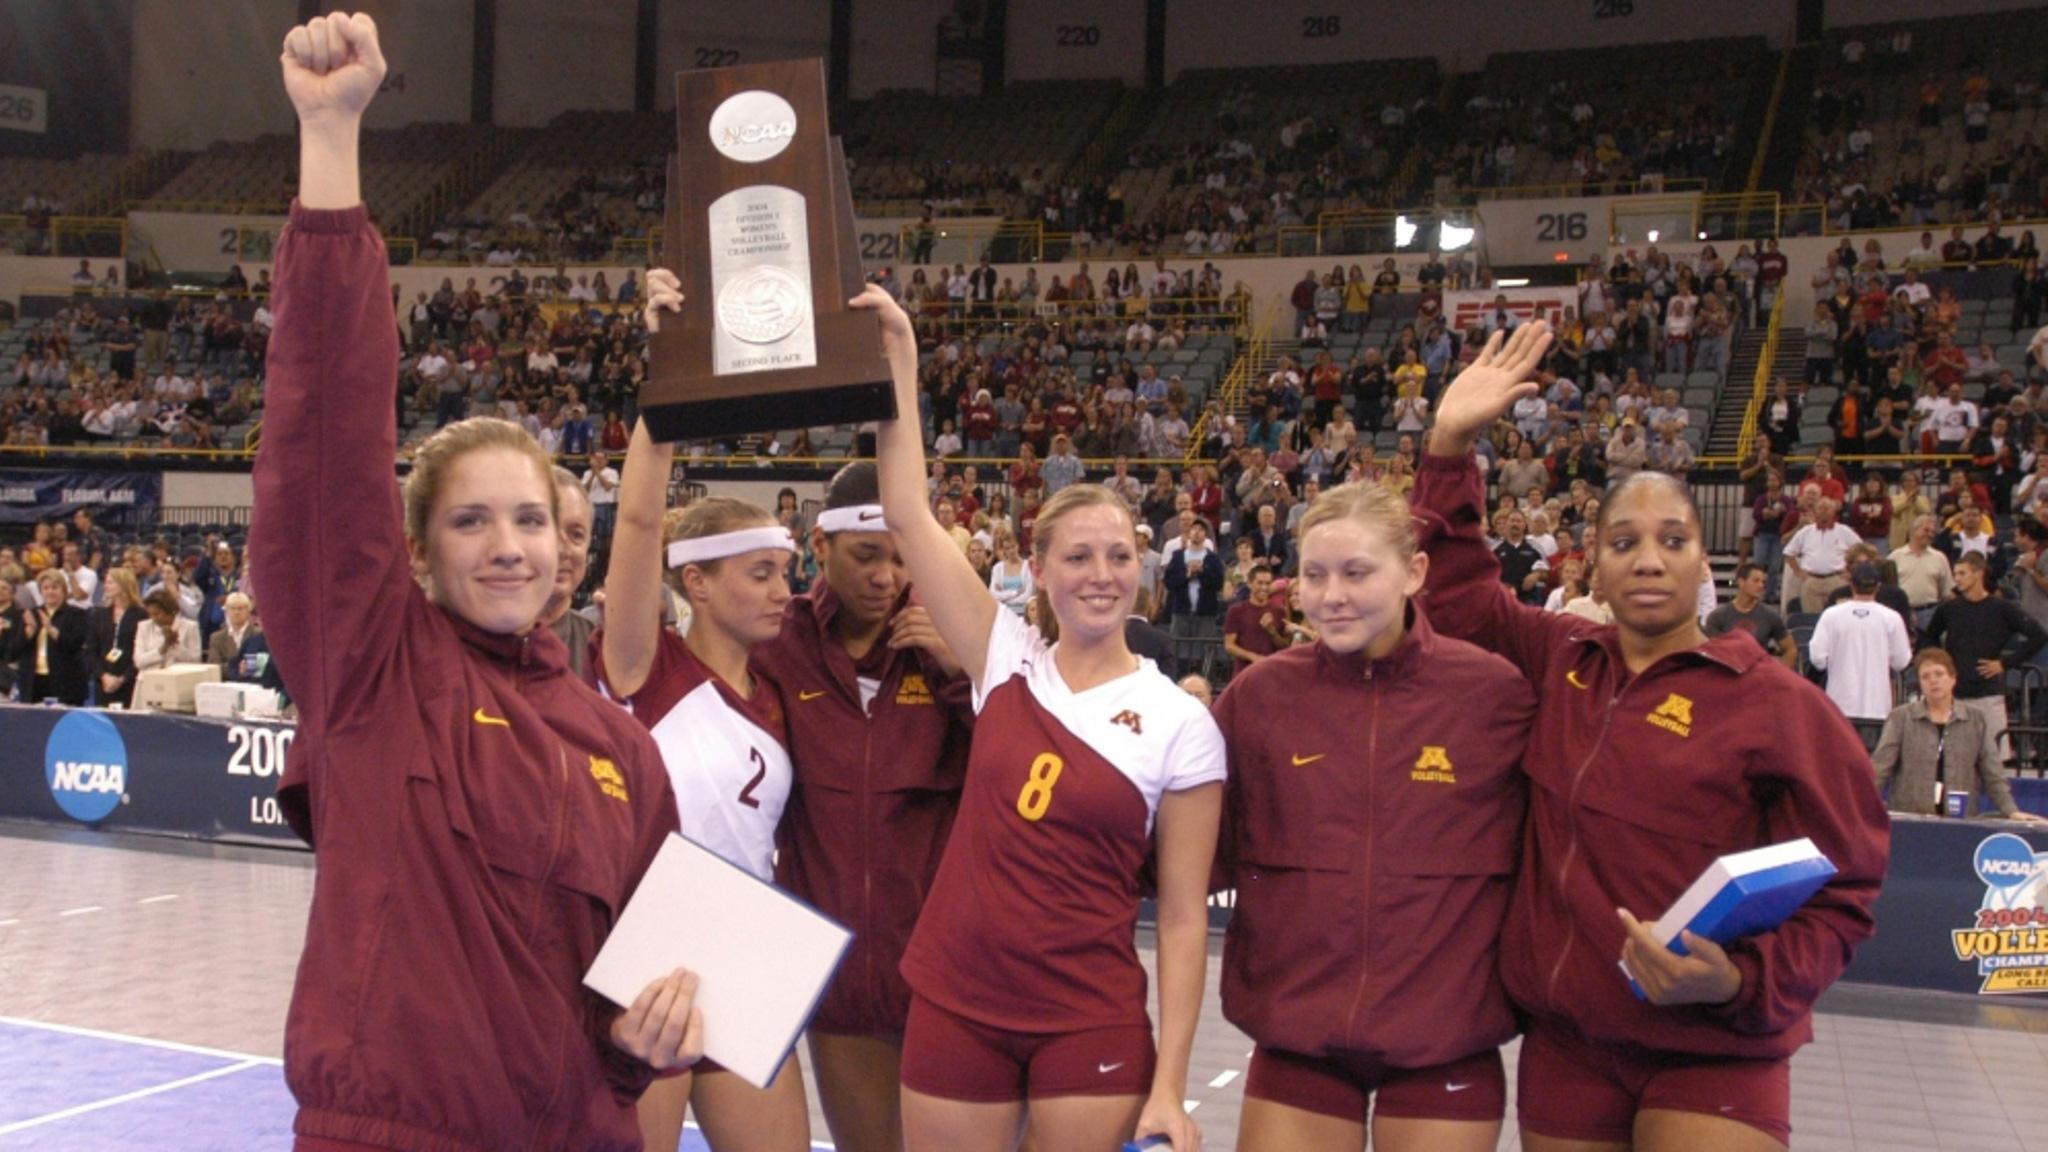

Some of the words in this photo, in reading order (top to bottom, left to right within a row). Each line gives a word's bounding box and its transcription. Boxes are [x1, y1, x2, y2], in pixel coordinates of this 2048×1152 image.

[1057, 25, 1099, 46] 220
[1537, 212, 1587, 242] 216
[731, 356, 768, 369] SECOND
[770, 353, 801, 365] PLACE
[53, 761, 124, 795] NCAA
[737, 746, 766, 809] 2
[1017, 752, 1063, 821] 8
[1982, 859, 2034, 876] NCAA
[1997, 968, 2031, 979] LONG
